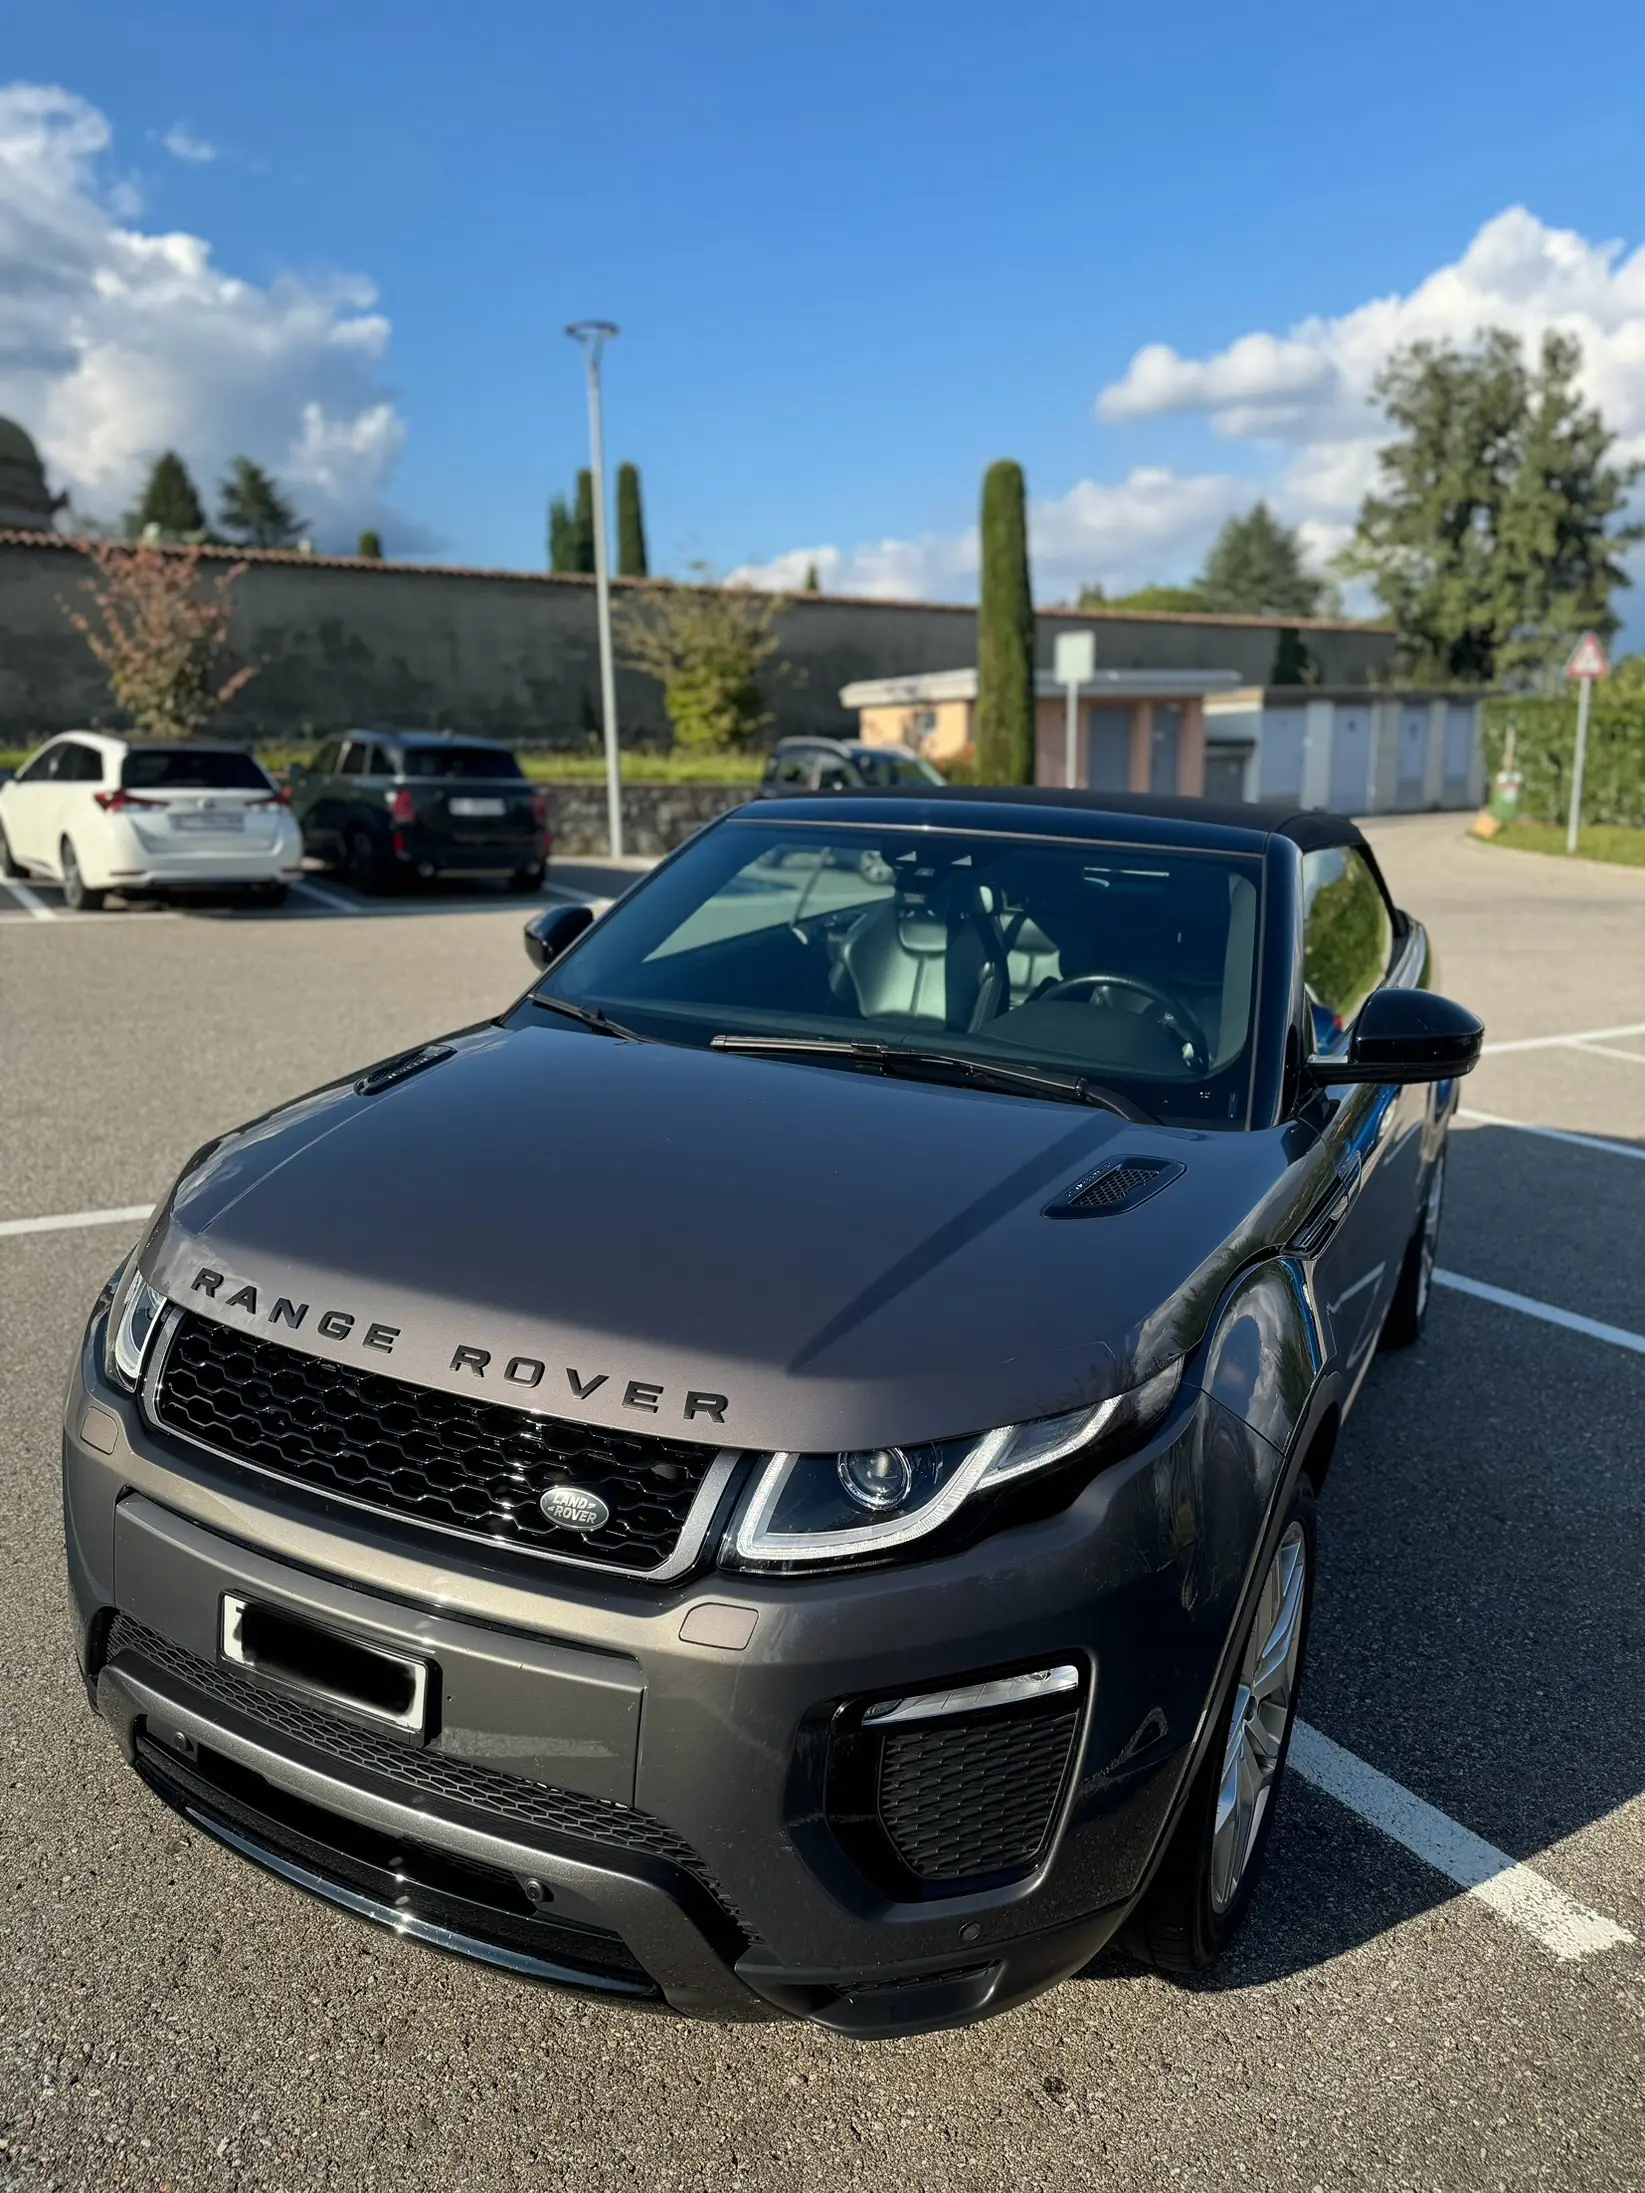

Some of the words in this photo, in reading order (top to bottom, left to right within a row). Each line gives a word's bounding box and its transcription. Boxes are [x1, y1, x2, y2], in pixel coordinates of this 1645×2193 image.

[190, 1267, 401, 1354] RANGE
[449, 1344, 729, 1424] ROVER
[552, 1491, 589, 1510] LAND
[553, 1505, 598, 1524] ROVER
